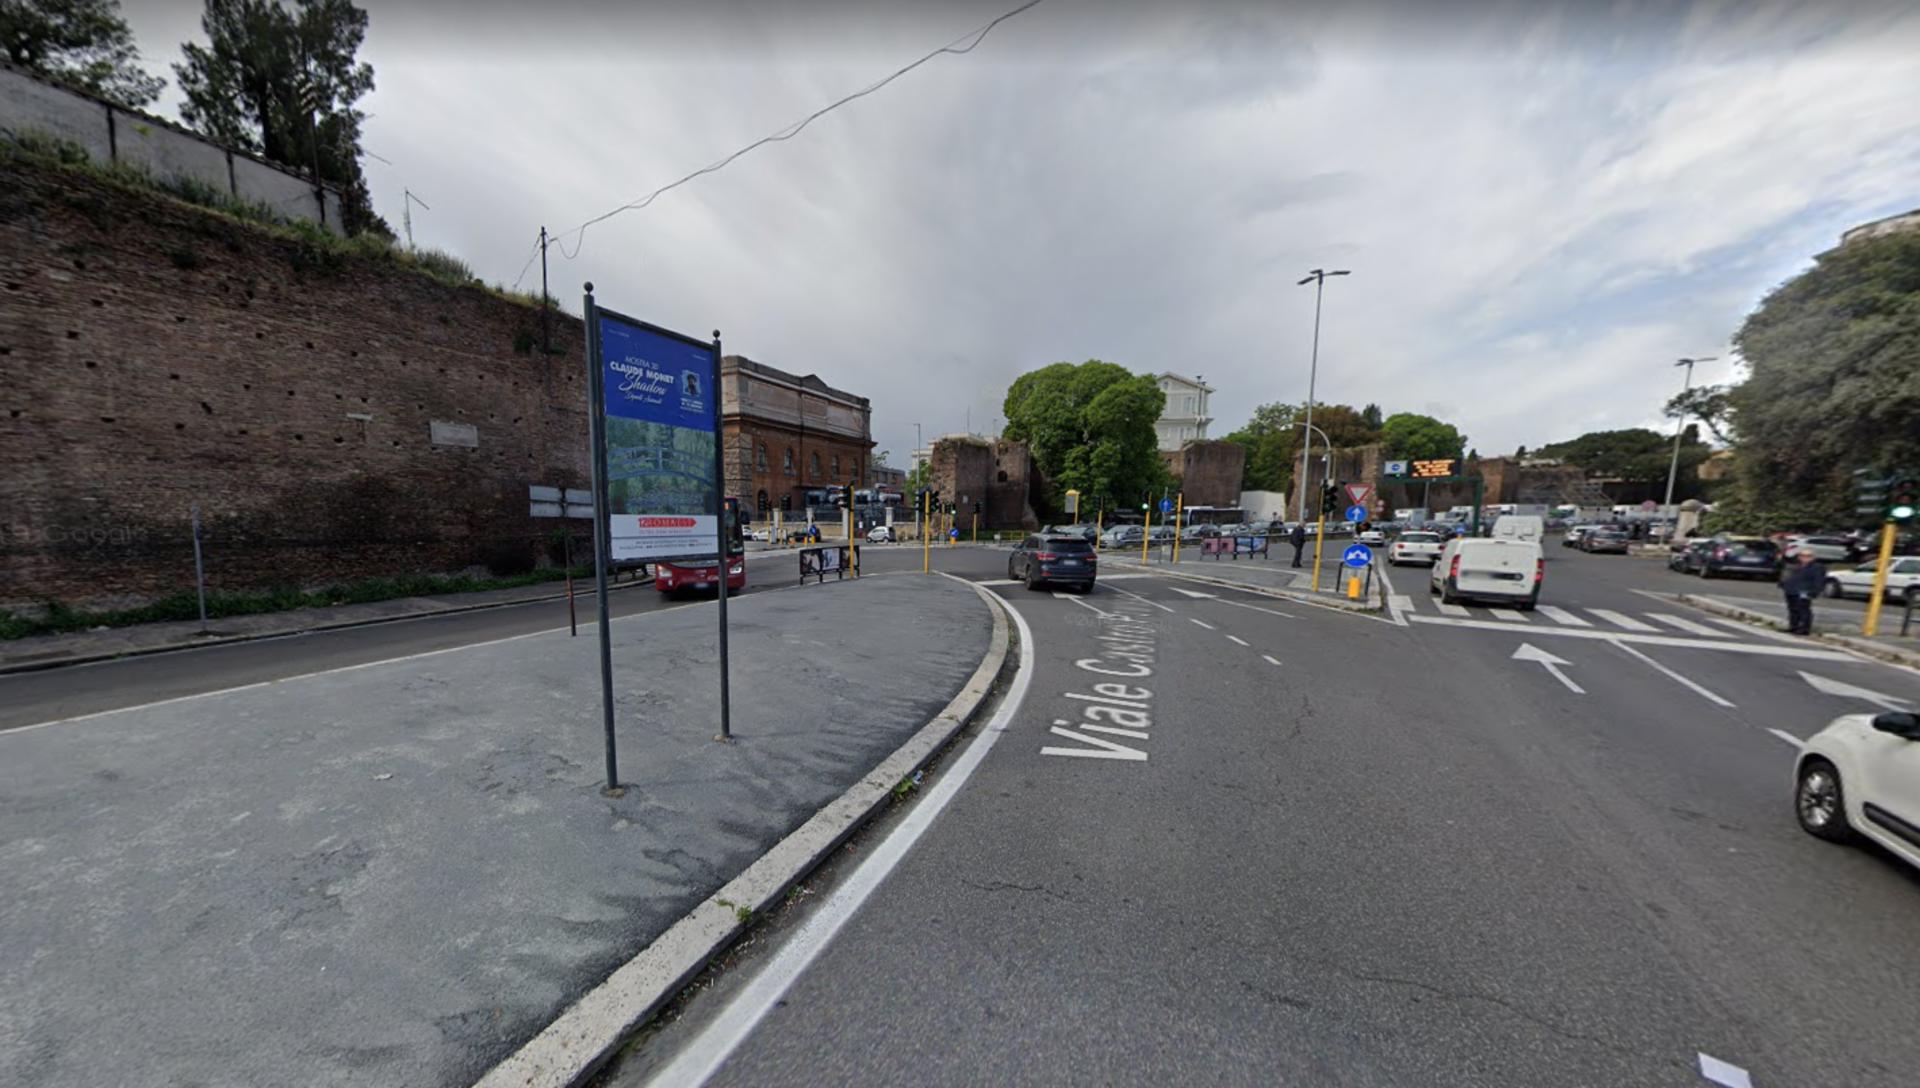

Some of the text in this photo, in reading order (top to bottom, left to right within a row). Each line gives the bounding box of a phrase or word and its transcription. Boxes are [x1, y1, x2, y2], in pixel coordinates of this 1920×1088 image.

[610, 361, 675, 384] CLAUDE MONET
[625, 356, 650, 367] MOSTRA
[618, 371, 667, 395] Shadow
